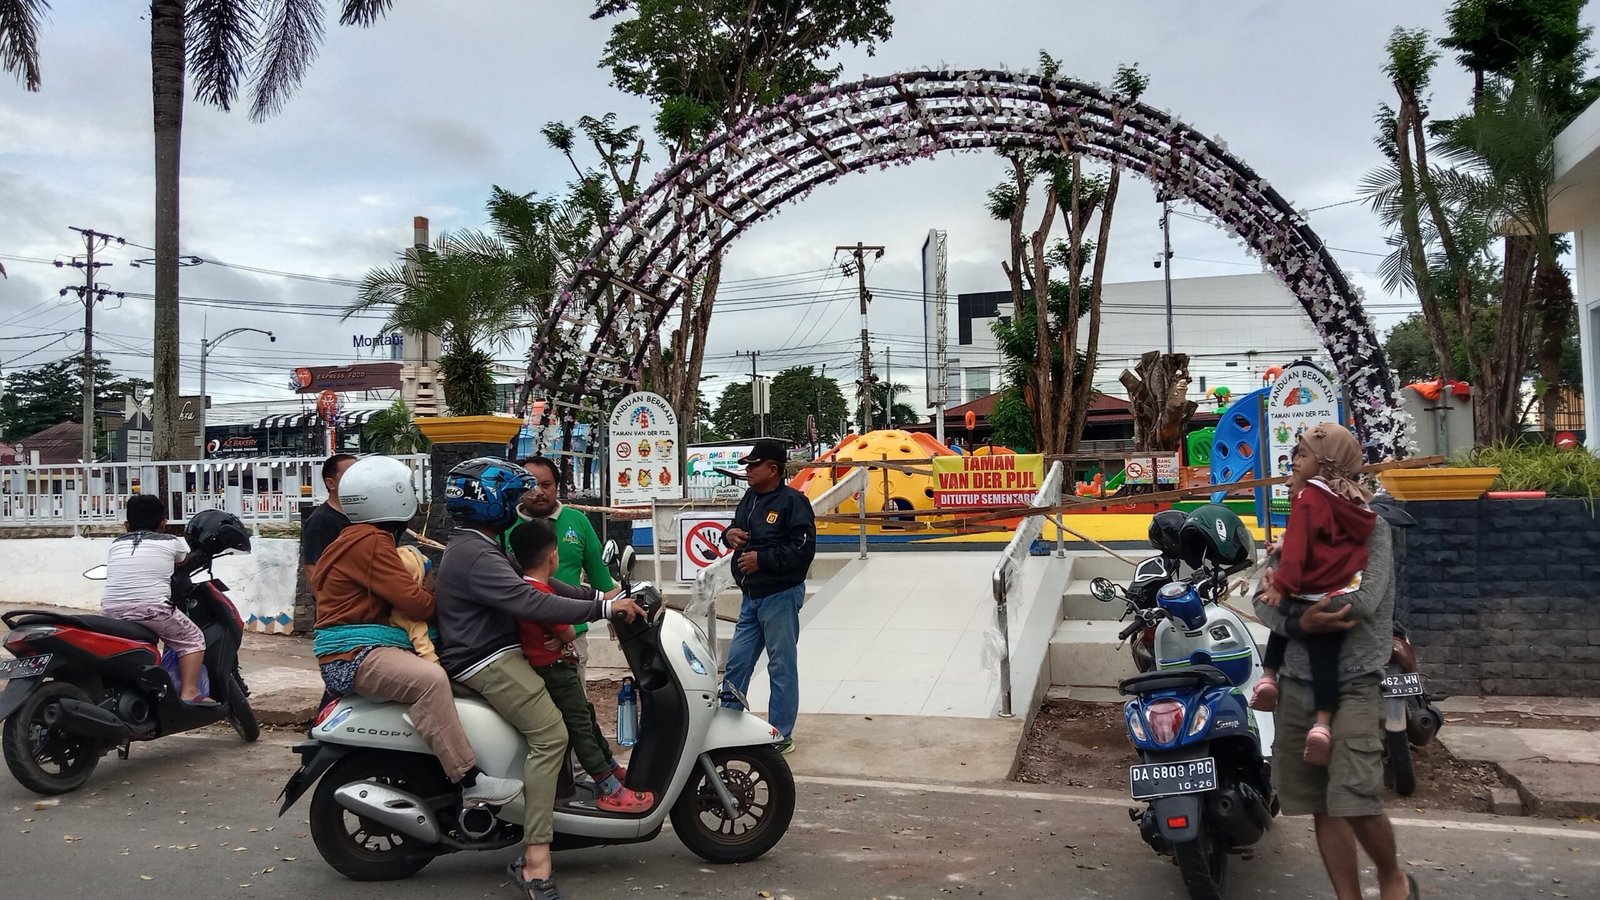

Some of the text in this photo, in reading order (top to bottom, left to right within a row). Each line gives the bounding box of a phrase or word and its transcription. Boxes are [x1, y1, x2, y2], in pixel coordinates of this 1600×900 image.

[1270, 370, 1335, 407] PANDUAN BERMAIN
[613, 395, 675, 426] PANDUAN BERMAIN
[962, 456, 1015, 471] TAMAN
[938, 471, 1037, 489] VAN DER PIJL
[941, 494, 979, 505] DITUTUP
[1404, 675, 1418, 685] WN
[347, 726, 412, 737] SCOOPY
[1133, 761, 1212, 781] DA 6808 PBG
